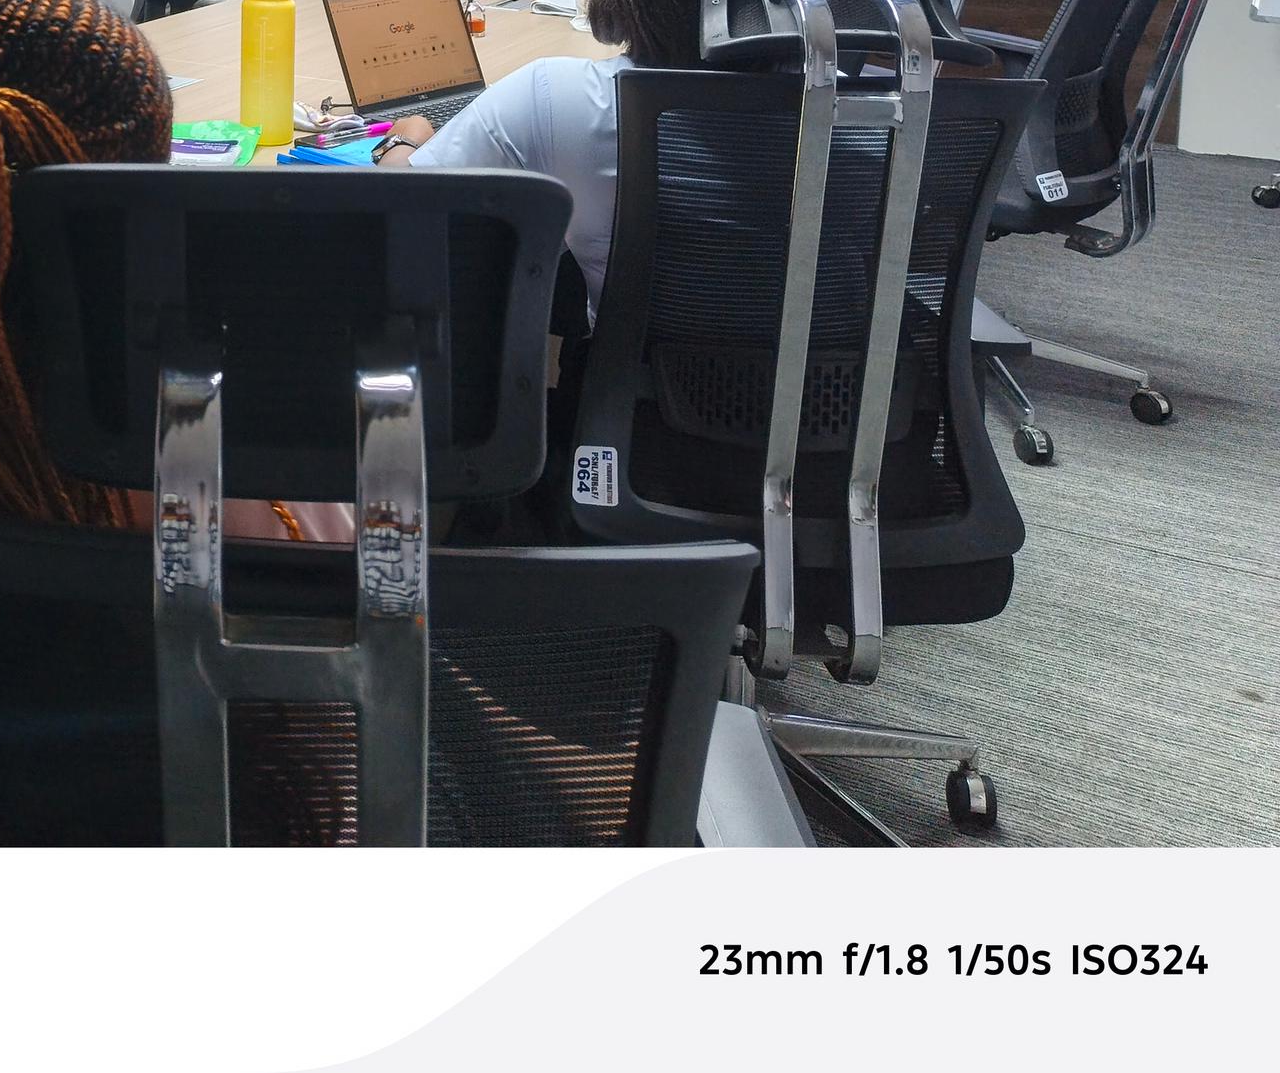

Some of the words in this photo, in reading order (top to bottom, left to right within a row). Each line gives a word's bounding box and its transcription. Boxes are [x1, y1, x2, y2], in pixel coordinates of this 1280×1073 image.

[389, 22, 416, 34] Google
[1048, 187, 1063, 198] 011
[577, 457, 590, 493] 064
